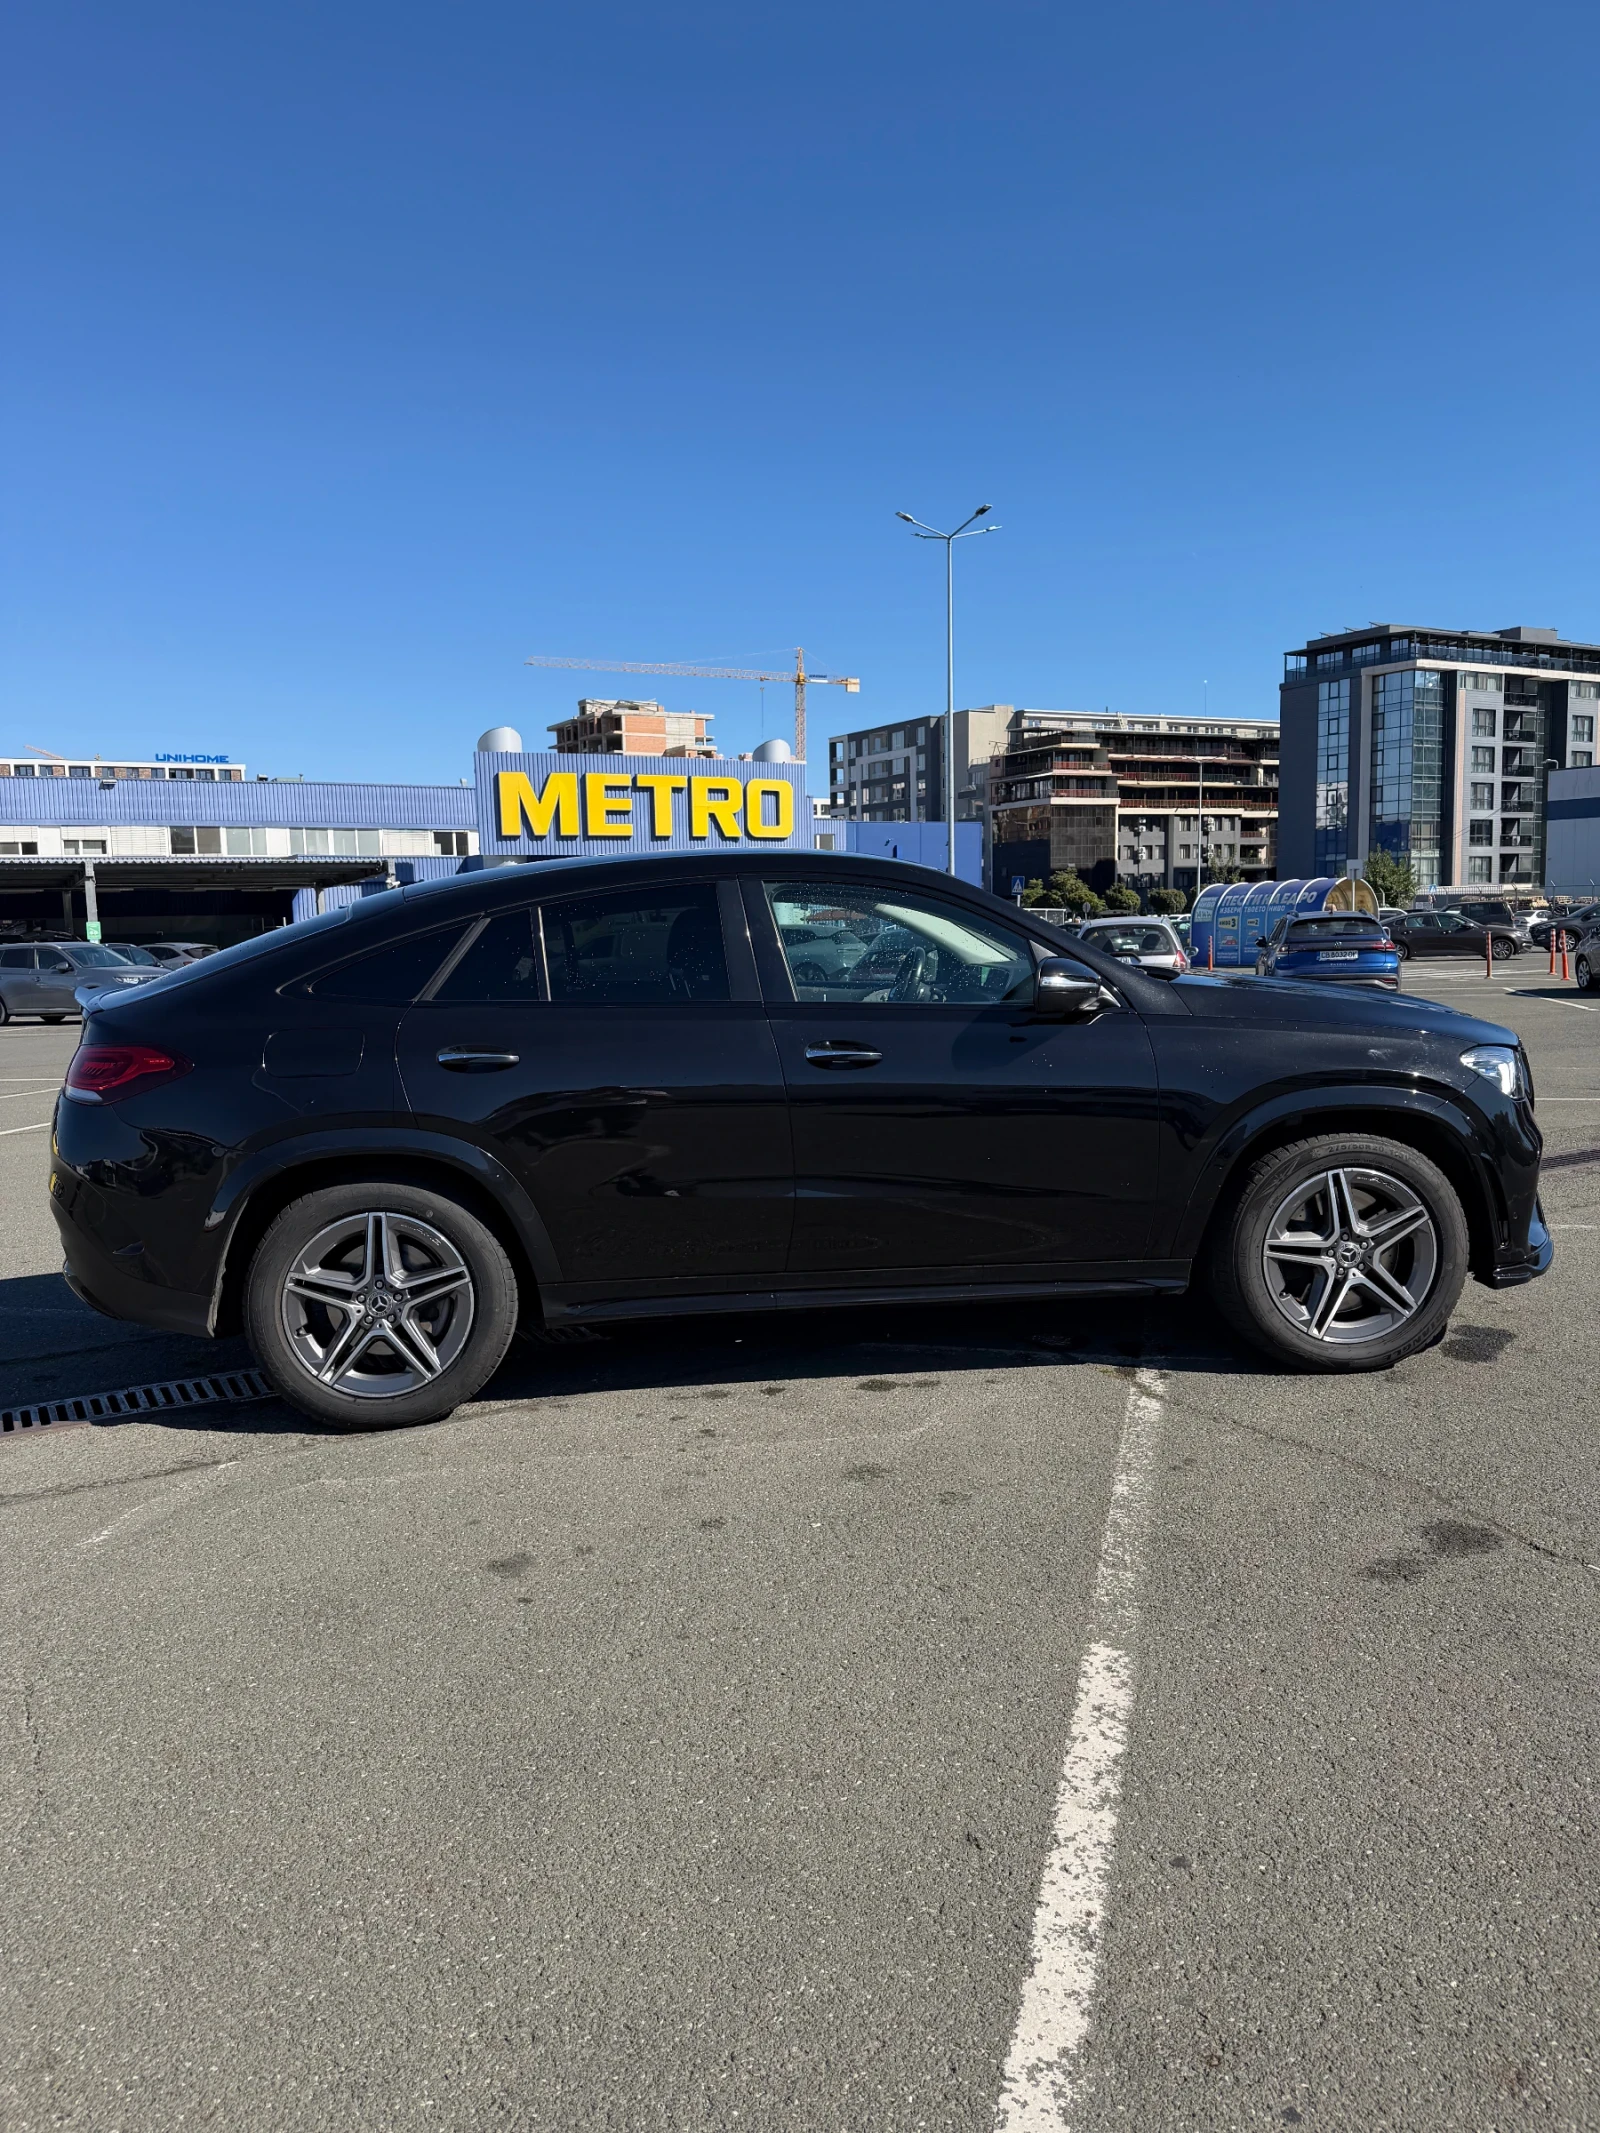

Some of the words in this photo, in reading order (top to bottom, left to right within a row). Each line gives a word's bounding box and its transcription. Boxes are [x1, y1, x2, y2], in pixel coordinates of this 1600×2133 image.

[155, 753, 229, 763] UNIHOME
[498, 771, 794, 839] METRO
[1244, 905, 1266, 913] ТВОЕТО
[1231, 918, 1236, 927] 3
